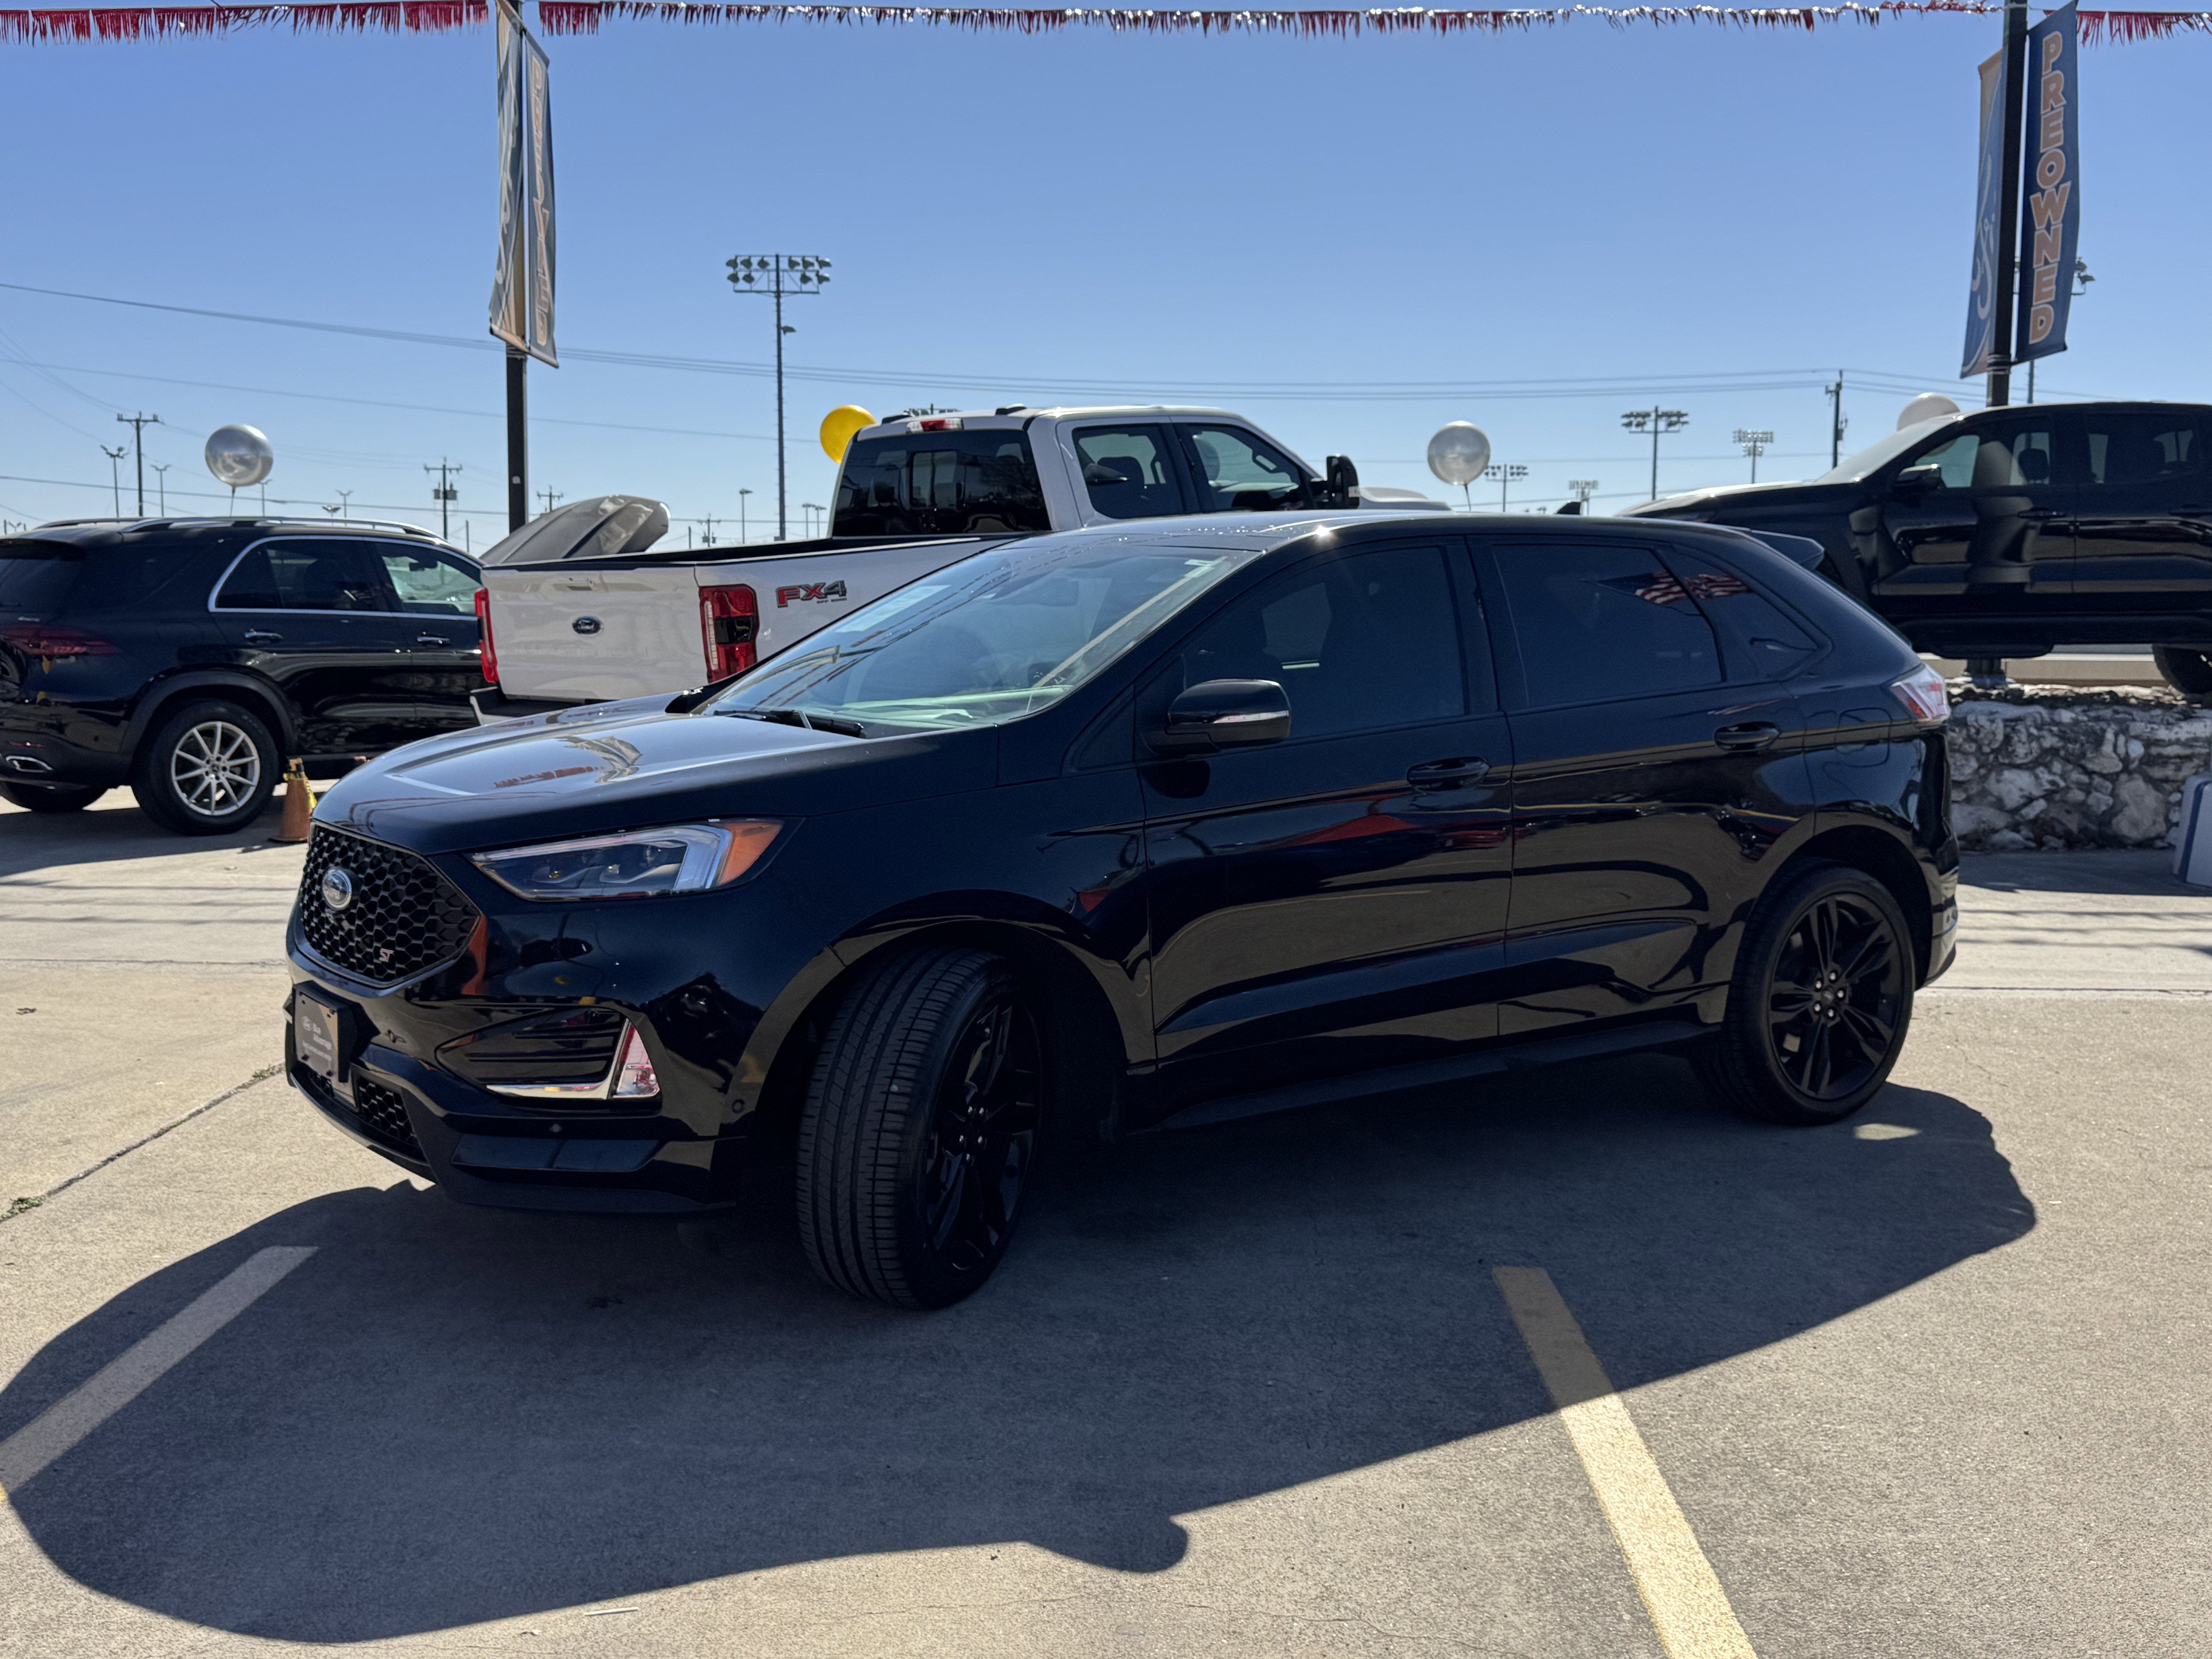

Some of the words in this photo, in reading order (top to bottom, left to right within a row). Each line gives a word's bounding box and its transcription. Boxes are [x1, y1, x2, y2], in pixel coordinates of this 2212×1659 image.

[2029, 31, 2071, 345] PREOWNED
[776, 580, 847, 608] FX4
[379, 949, 393, 962] ST
